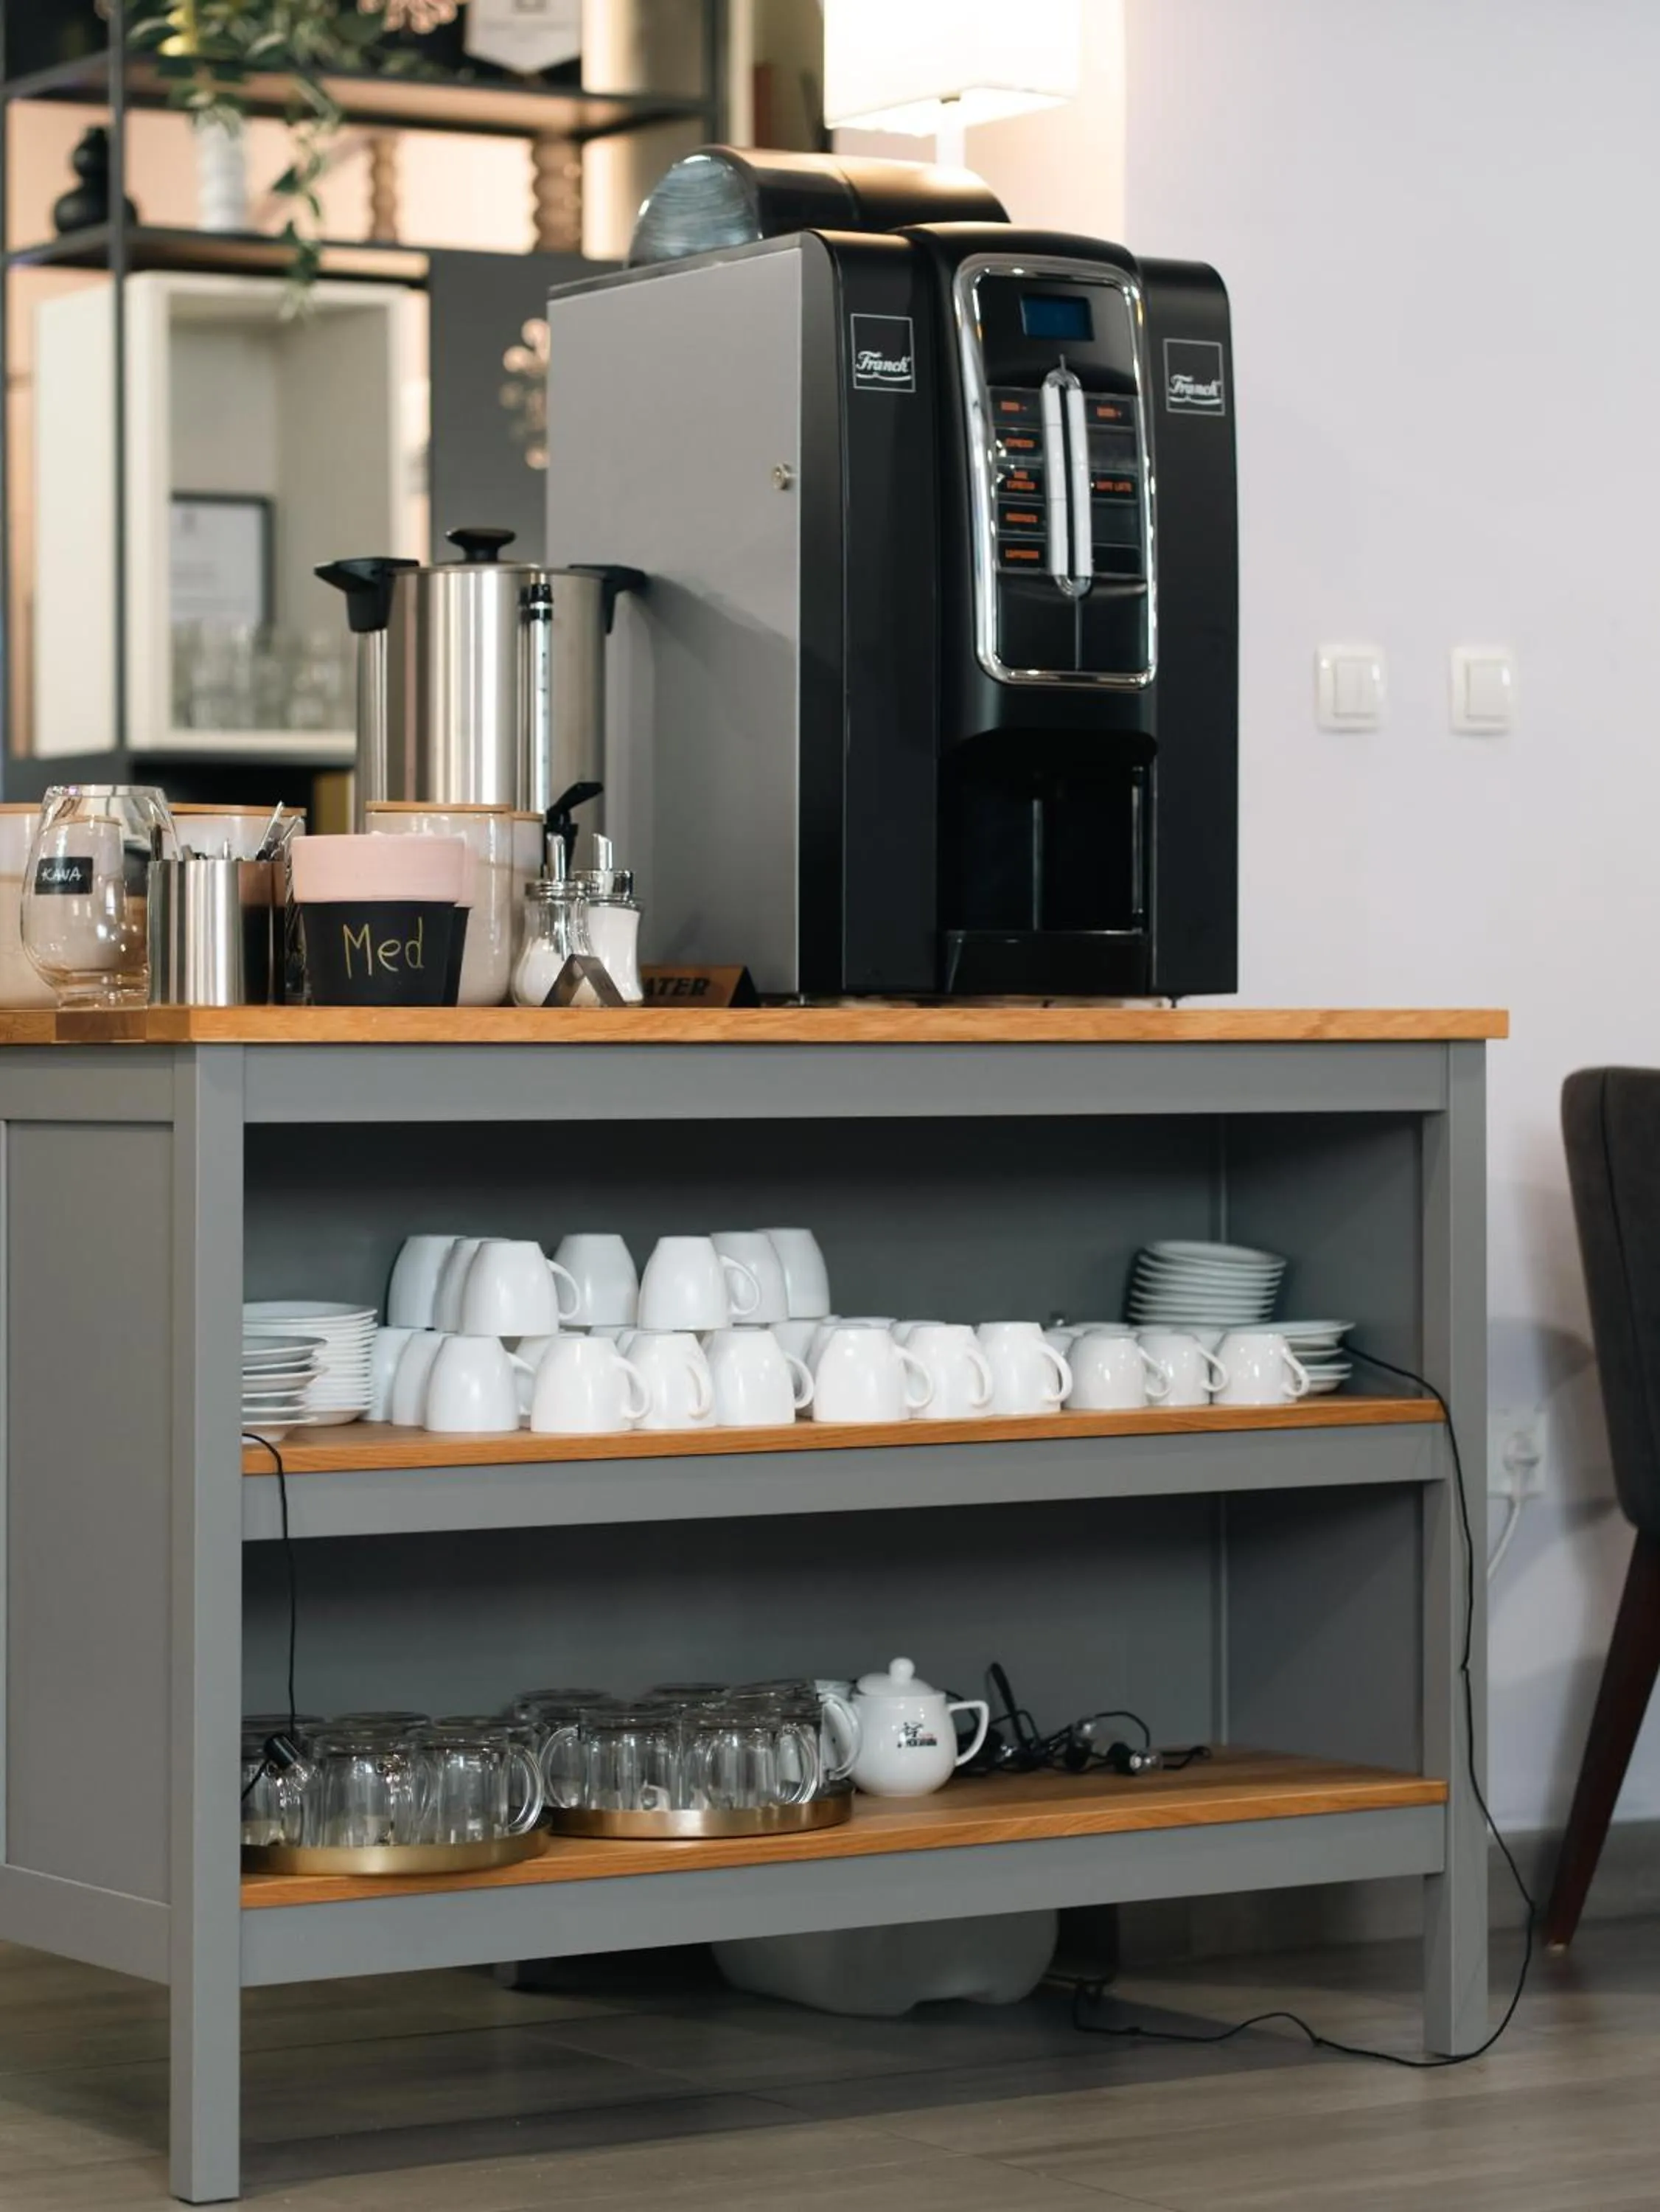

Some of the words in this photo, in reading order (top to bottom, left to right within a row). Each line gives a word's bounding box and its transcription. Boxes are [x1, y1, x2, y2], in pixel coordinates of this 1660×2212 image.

[856, 351, 911, 373] Franck
[41, 866, 83, 881] KAVA
[343, 917, 425, 980] Med
[641, 976, 711, 996] ATER
